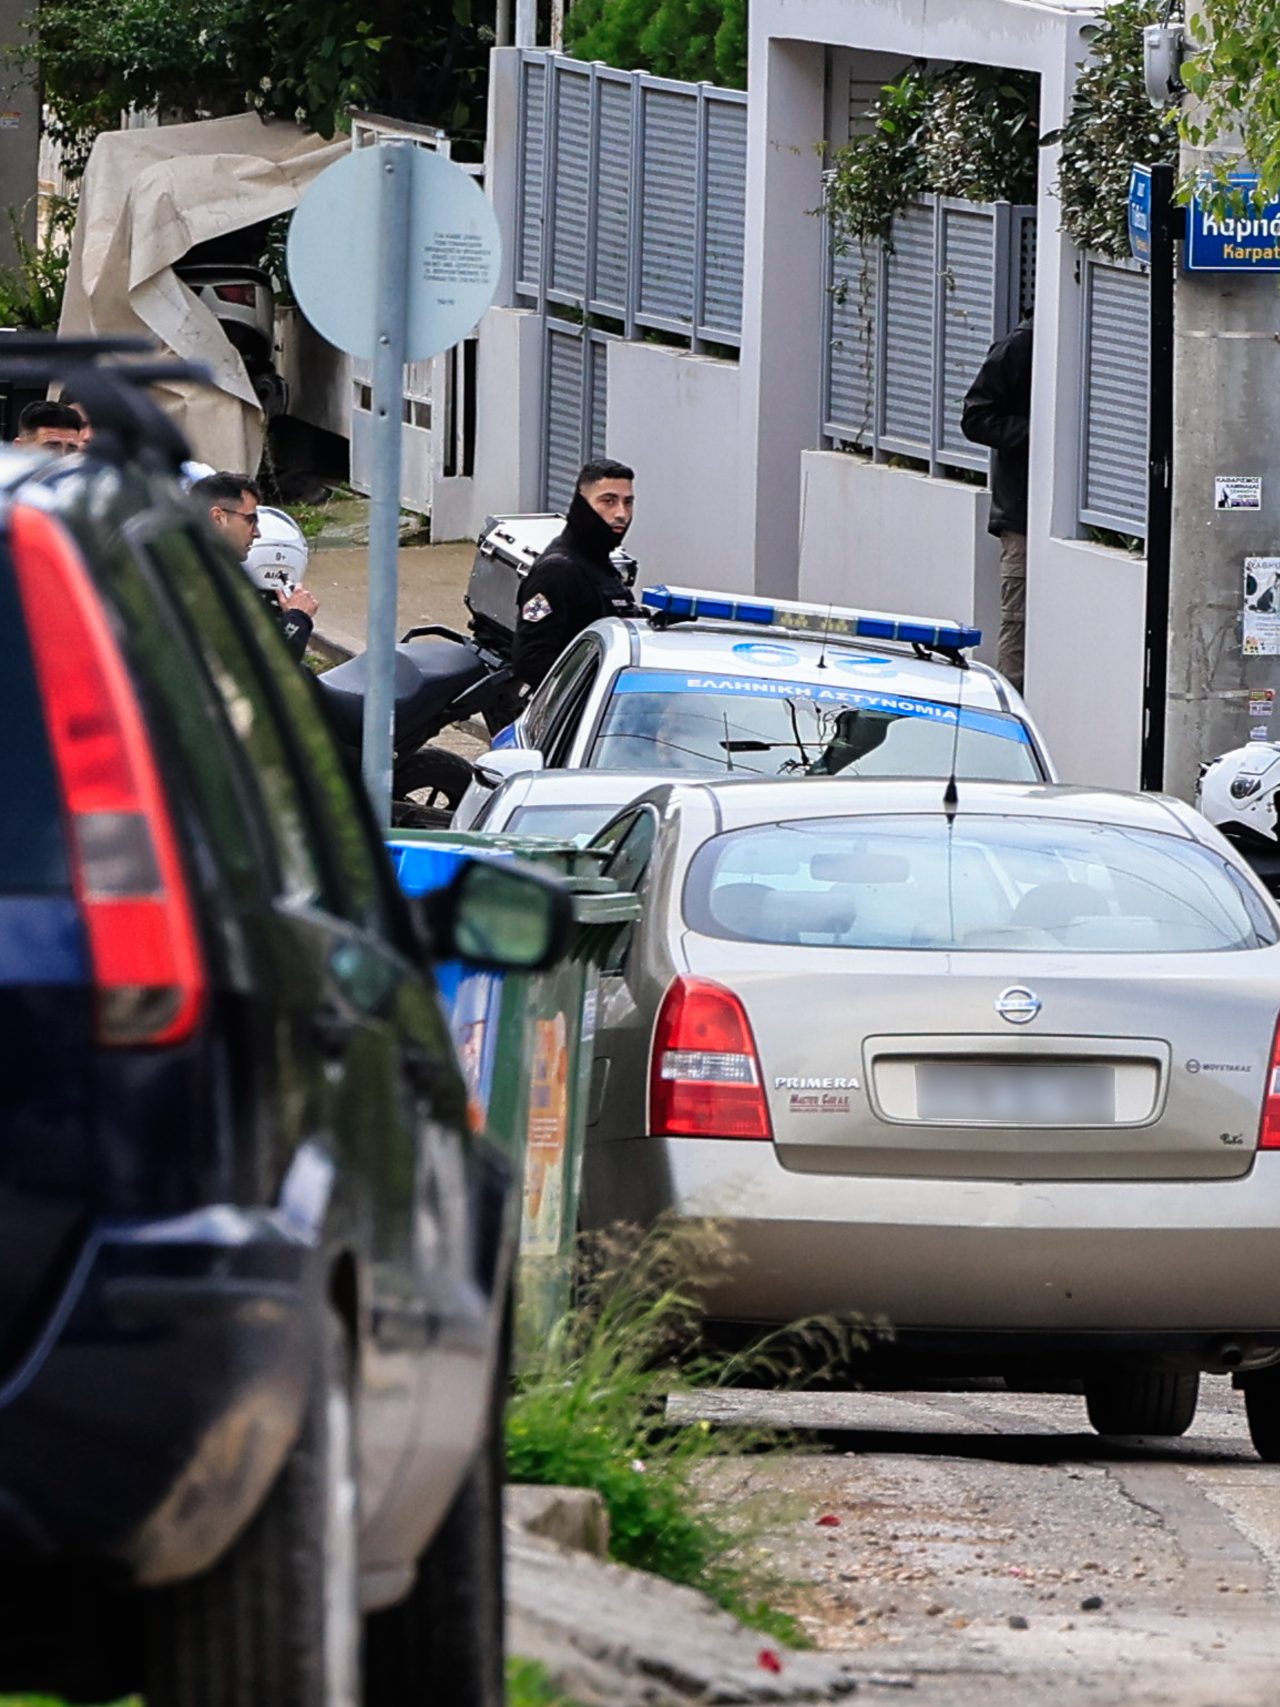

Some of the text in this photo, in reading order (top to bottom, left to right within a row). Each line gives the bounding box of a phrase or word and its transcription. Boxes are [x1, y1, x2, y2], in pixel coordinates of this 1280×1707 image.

[687, 679, 958, 720] ΕΛΛΗΝΙΚΗ ΑΣΤΥΝΟΜΙΑ
[775, 1077, 861, 1089] PRIMERA
